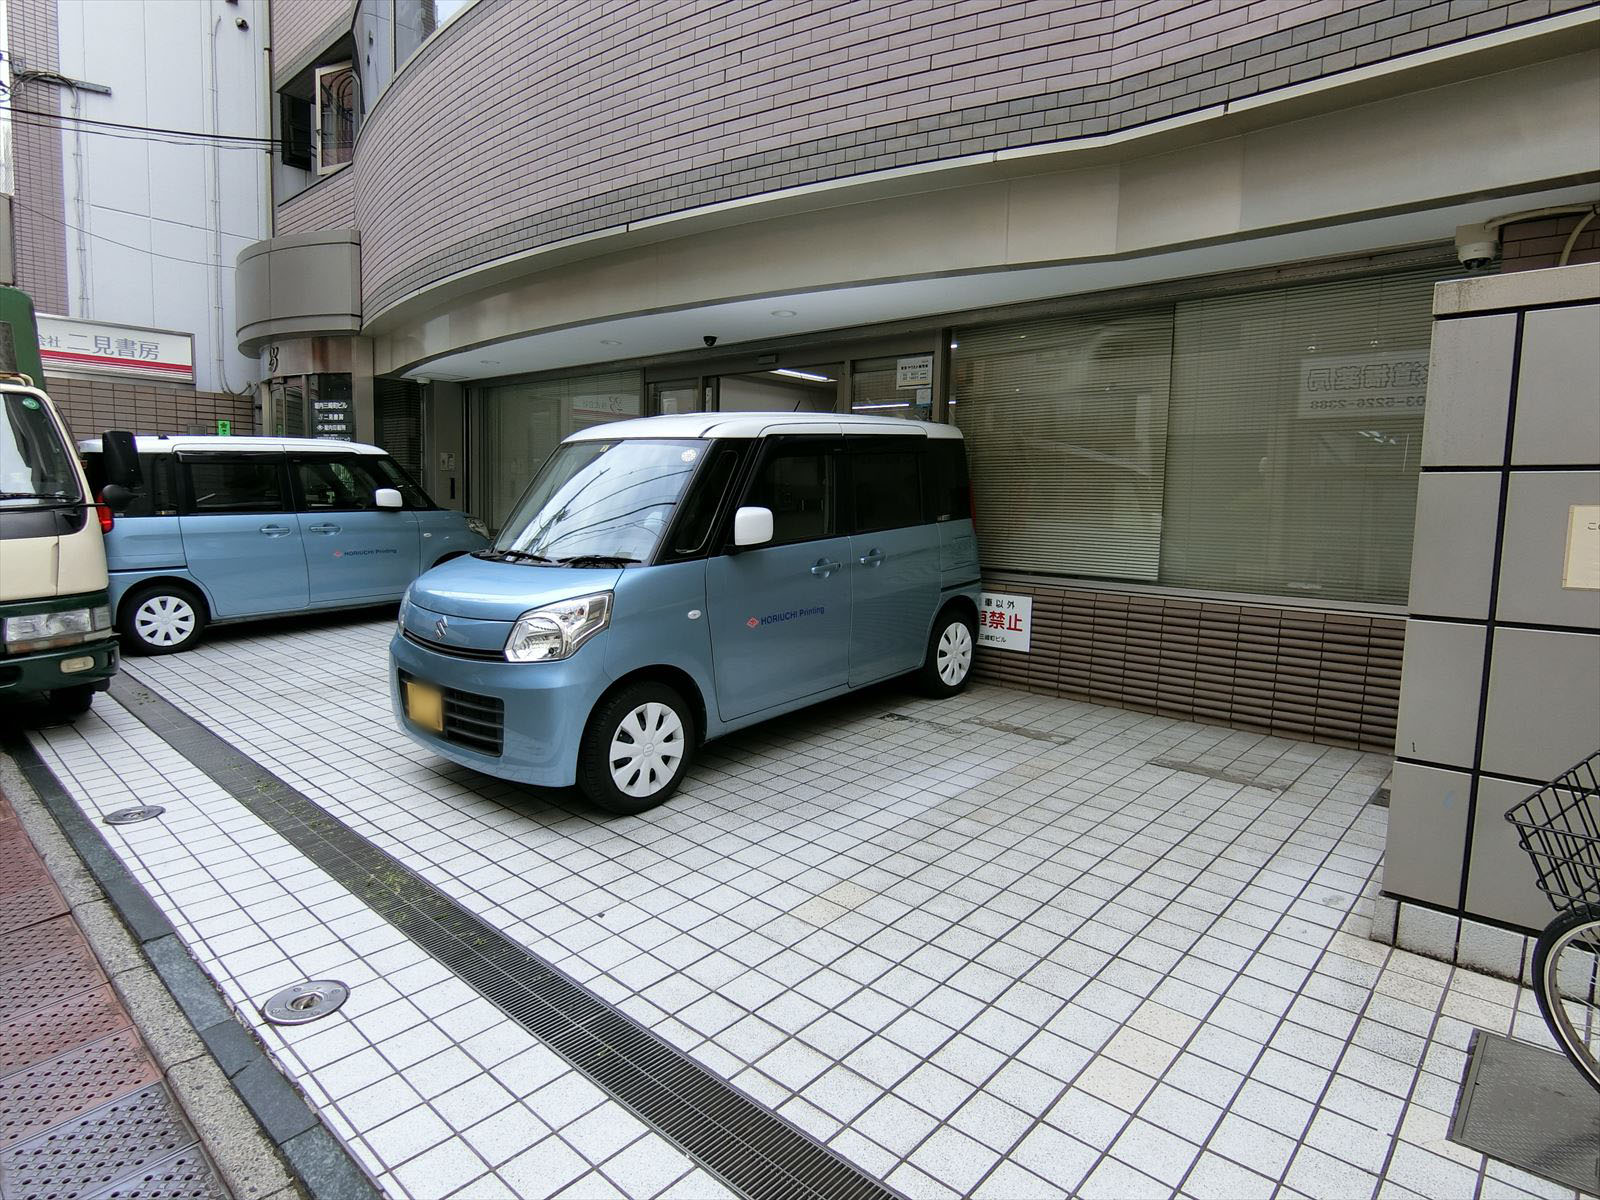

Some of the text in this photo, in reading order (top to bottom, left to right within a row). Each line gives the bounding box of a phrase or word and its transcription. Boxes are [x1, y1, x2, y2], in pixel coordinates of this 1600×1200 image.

[67, 333, 161, 360] 二見書房
[984, 597, 1016, 610] 車以外
[760, 606, 825, 625] HORIUCHI Printing
